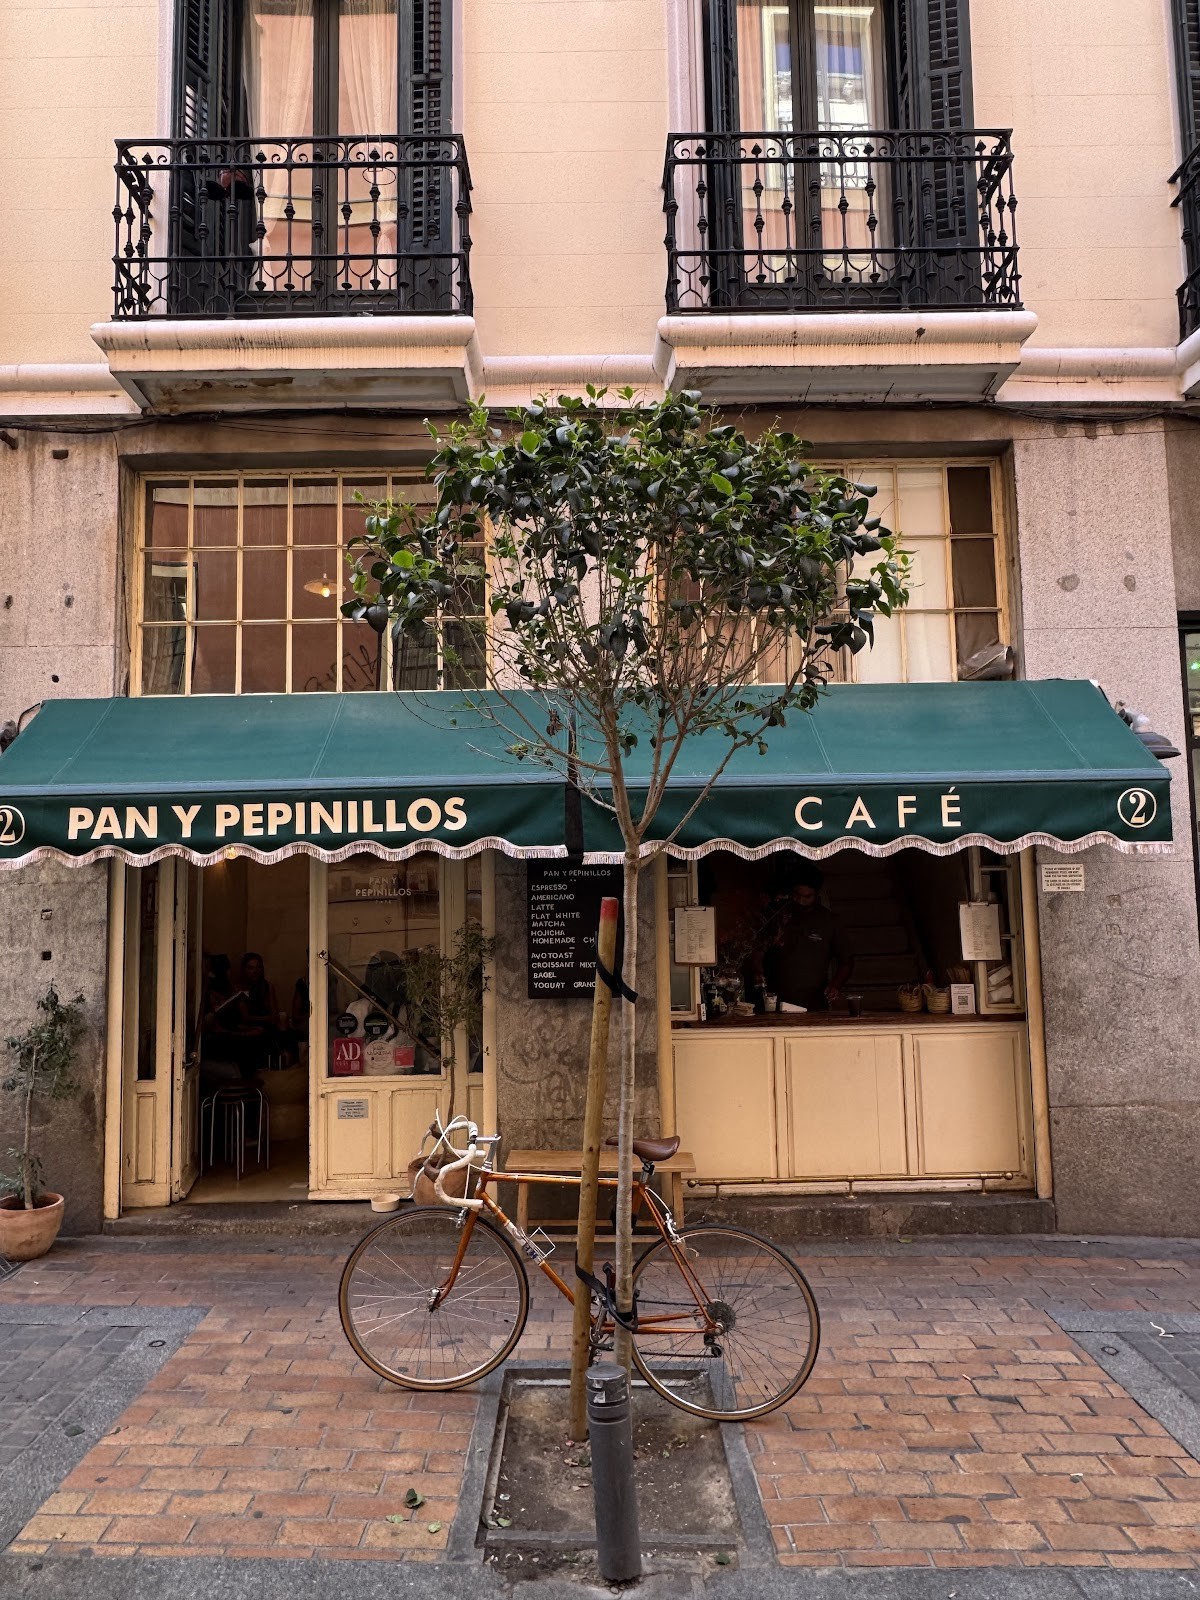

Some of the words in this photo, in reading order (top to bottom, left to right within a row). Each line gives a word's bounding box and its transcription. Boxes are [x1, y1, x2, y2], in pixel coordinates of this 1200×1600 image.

[794, 786, 962, 830] CAFÉ
[1128, 791, 1148, 825] 2
[67, 806, 158, 840] PAN
[171, 804, 202, 838] Y
[215, 796, 468, 837] PEPINILLOS
[531, 883, 568, 891] ESPRESSO
[355, 888, 412, 897] PEPINILLOS
[531, 893, 575, 901] AMERICANO
[531, 903, 555, 911] LATTE
[555, 911, 580, 919] WHITE
[531, 920, 566, 928] MATCHA
[531, 929, 566, 937] HOJICHA
[532, 936, 576, 945] HOMEMADE
[583, 936, 595, 944] CH
[531, 961, 575, 969] CROISSANT
[579, 961, 597, 969] MIXT
[533, 971, 557, 979] BAGEL
[533, 981, 566, 989] YOGURT
[573, 981, 596, 989] GRANO
[336, 1042, 361, 1061] AD
